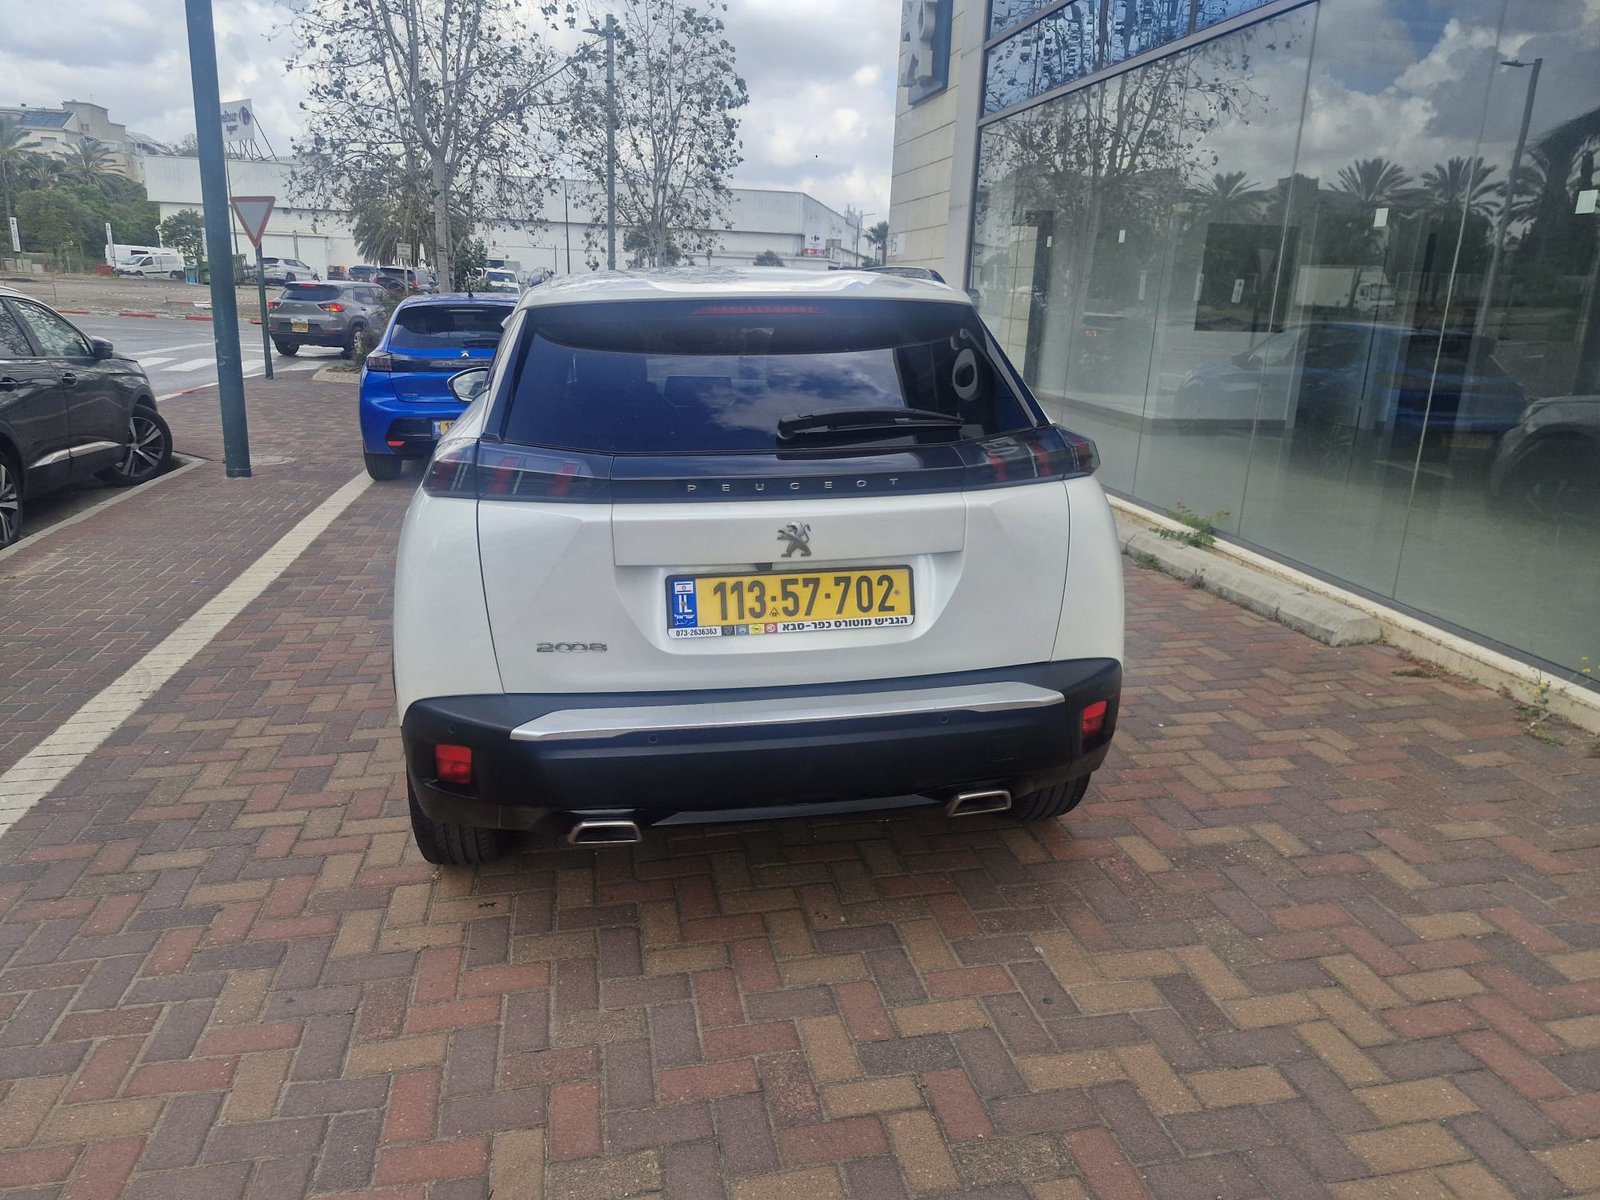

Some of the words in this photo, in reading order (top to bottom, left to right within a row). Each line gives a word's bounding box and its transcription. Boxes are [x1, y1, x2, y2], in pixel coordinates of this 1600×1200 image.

[687, 477, 899, 493] PEUGEOT
[678, 594, 693, 613] IL
[782, 620, 832, 632] כפר-סבא
[834, 617, 872, 628] מוטורס
[874, 616, 908, 626] הגביש
[536, 642, 608, 653] 2008
